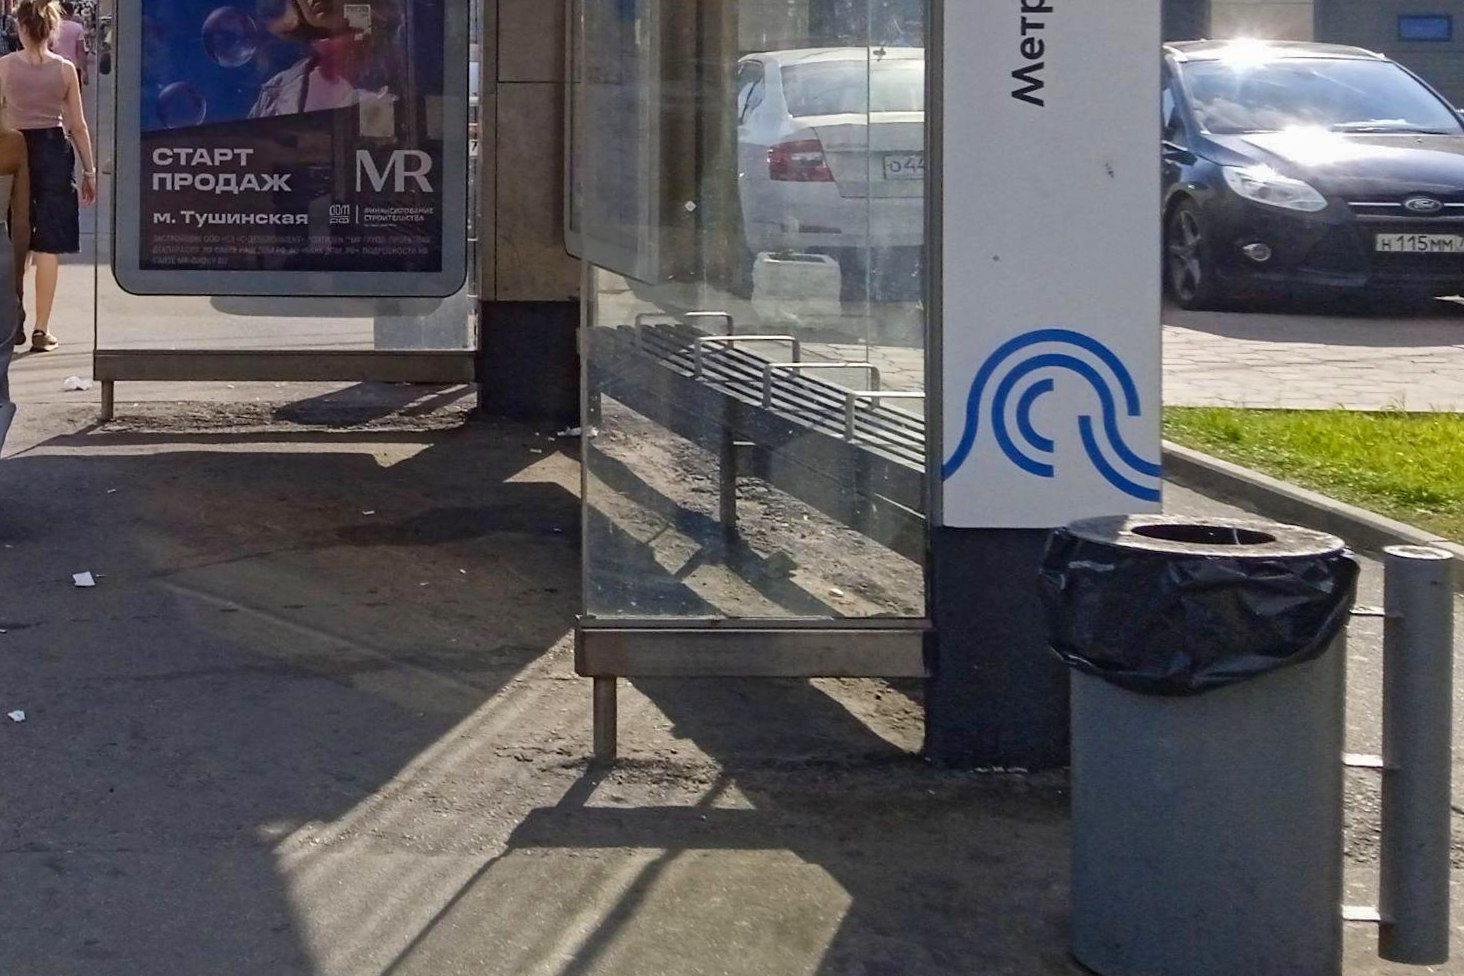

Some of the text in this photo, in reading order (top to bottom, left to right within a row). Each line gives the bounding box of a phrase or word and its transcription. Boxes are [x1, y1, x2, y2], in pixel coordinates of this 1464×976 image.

[151, 147, 254, 167] СТАРТ
[355, 149, 435, 193] MR
[151, 173, 292, 195] ПРОДАЖ
[152, 210, 309, 229] м. Тушинская
